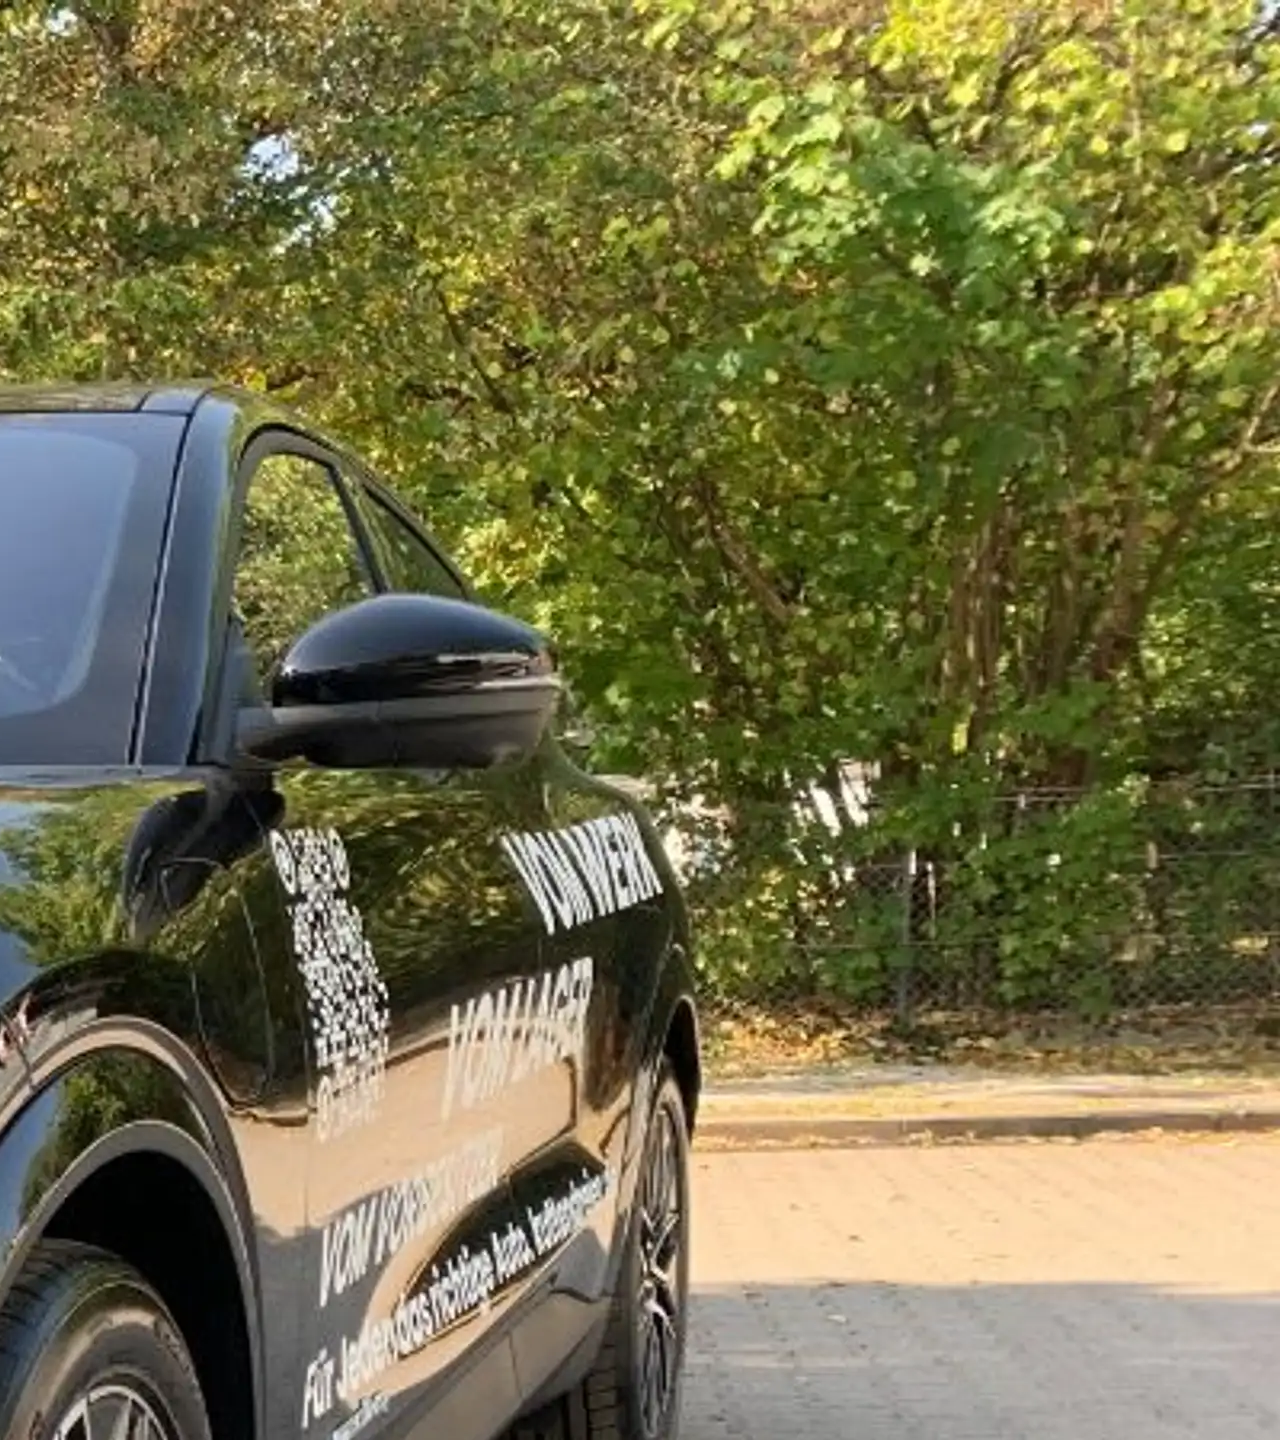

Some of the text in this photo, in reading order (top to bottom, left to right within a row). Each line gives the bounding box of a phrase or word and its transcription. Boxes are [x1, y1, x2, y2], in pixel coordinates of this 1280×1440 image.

[500, 810, 664, 936] VOM WERK
[319, 1194, 378, 1308] VOM
[302, 1347, 334, 1429] Für
[392, 1288, 436, 1357] das
